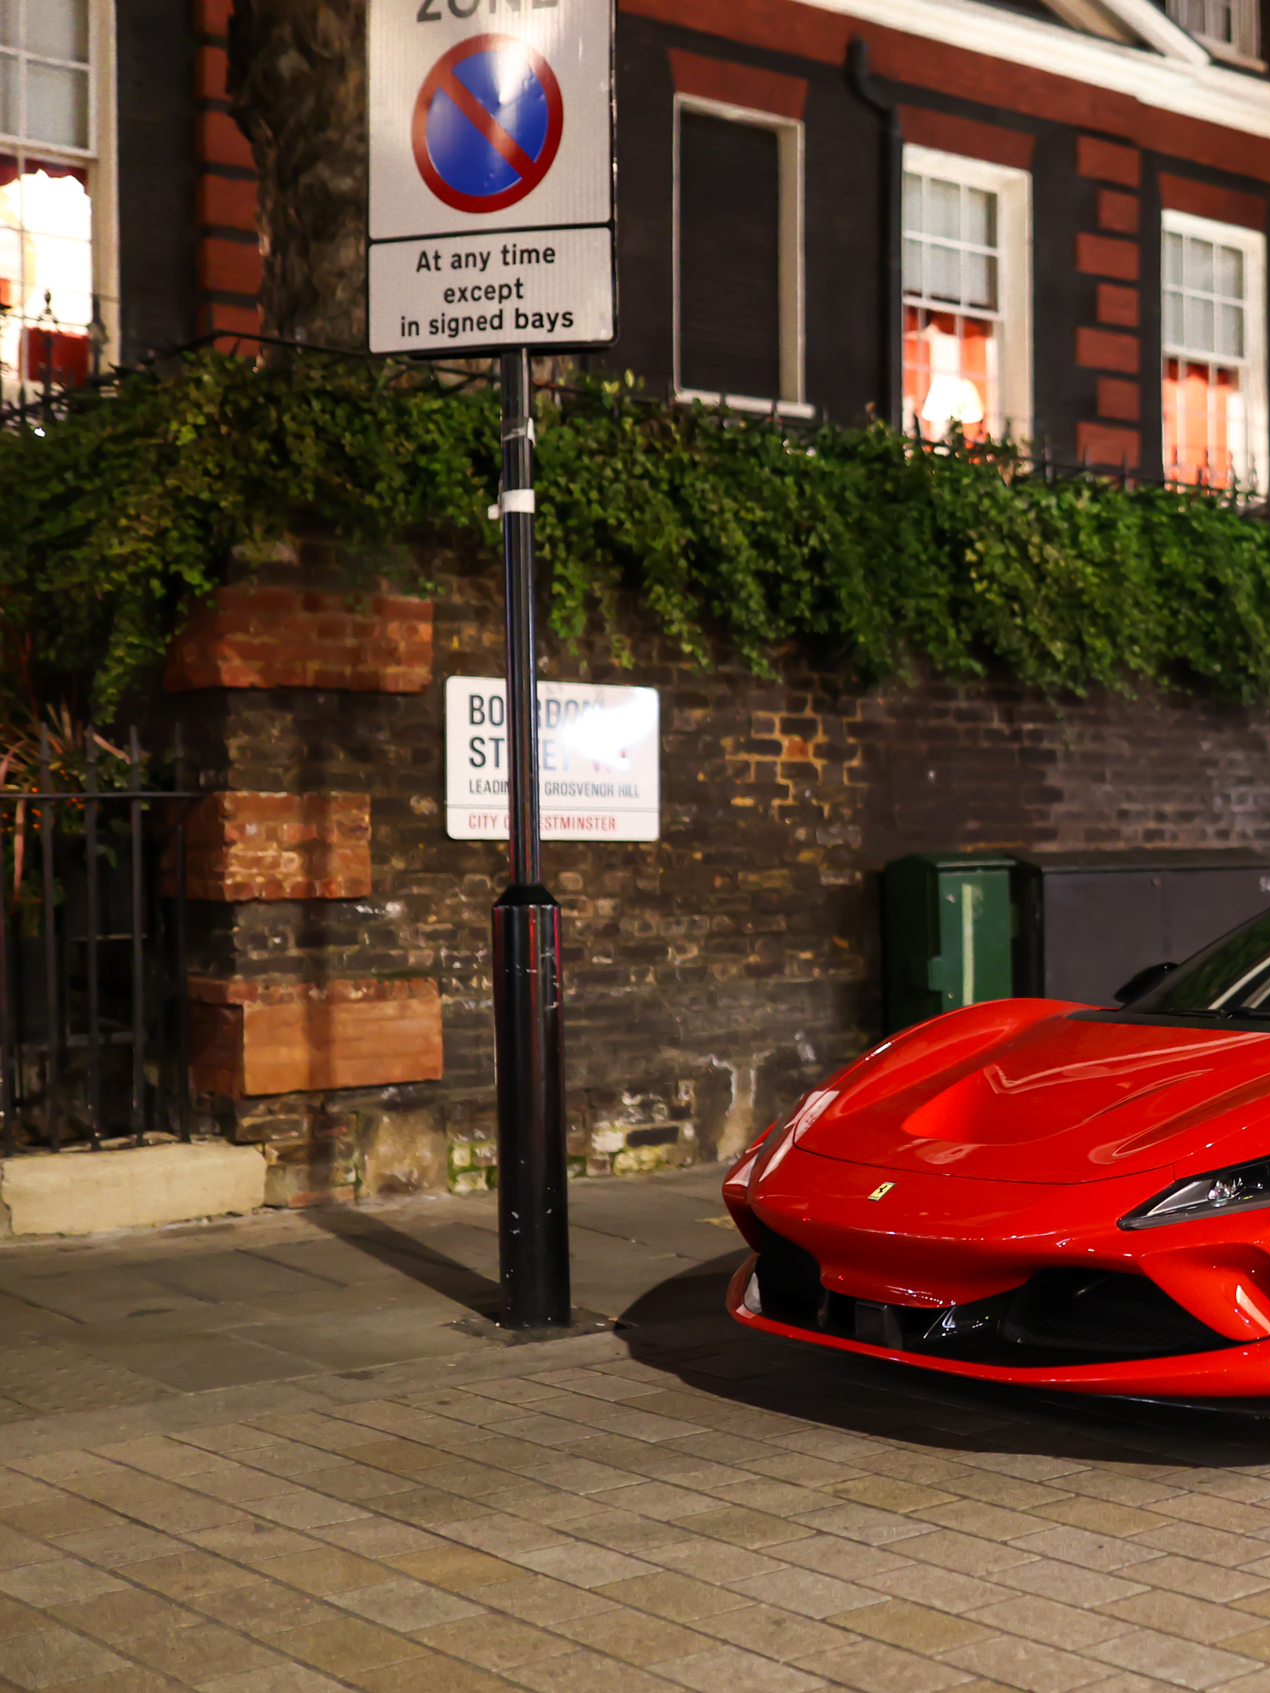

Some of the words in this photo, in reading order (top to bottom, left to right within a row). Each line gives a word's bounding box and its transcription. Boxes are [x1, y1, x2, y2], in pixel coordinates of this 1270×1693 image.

[416, 250, 441, 273] At
[450, 251, 491, 272] any
[501, 243, 556, 266] time
[443, 277, 524, 304] except
[401, 316, 420, 337] in
[429, 308, 503, 338] signed
[515, 307, 574, 333] bays
[544, 781, 614, 798] GROSVENOR
[618, 783, 640, 798] HILL
[469, 813, 498, 829] CITY
